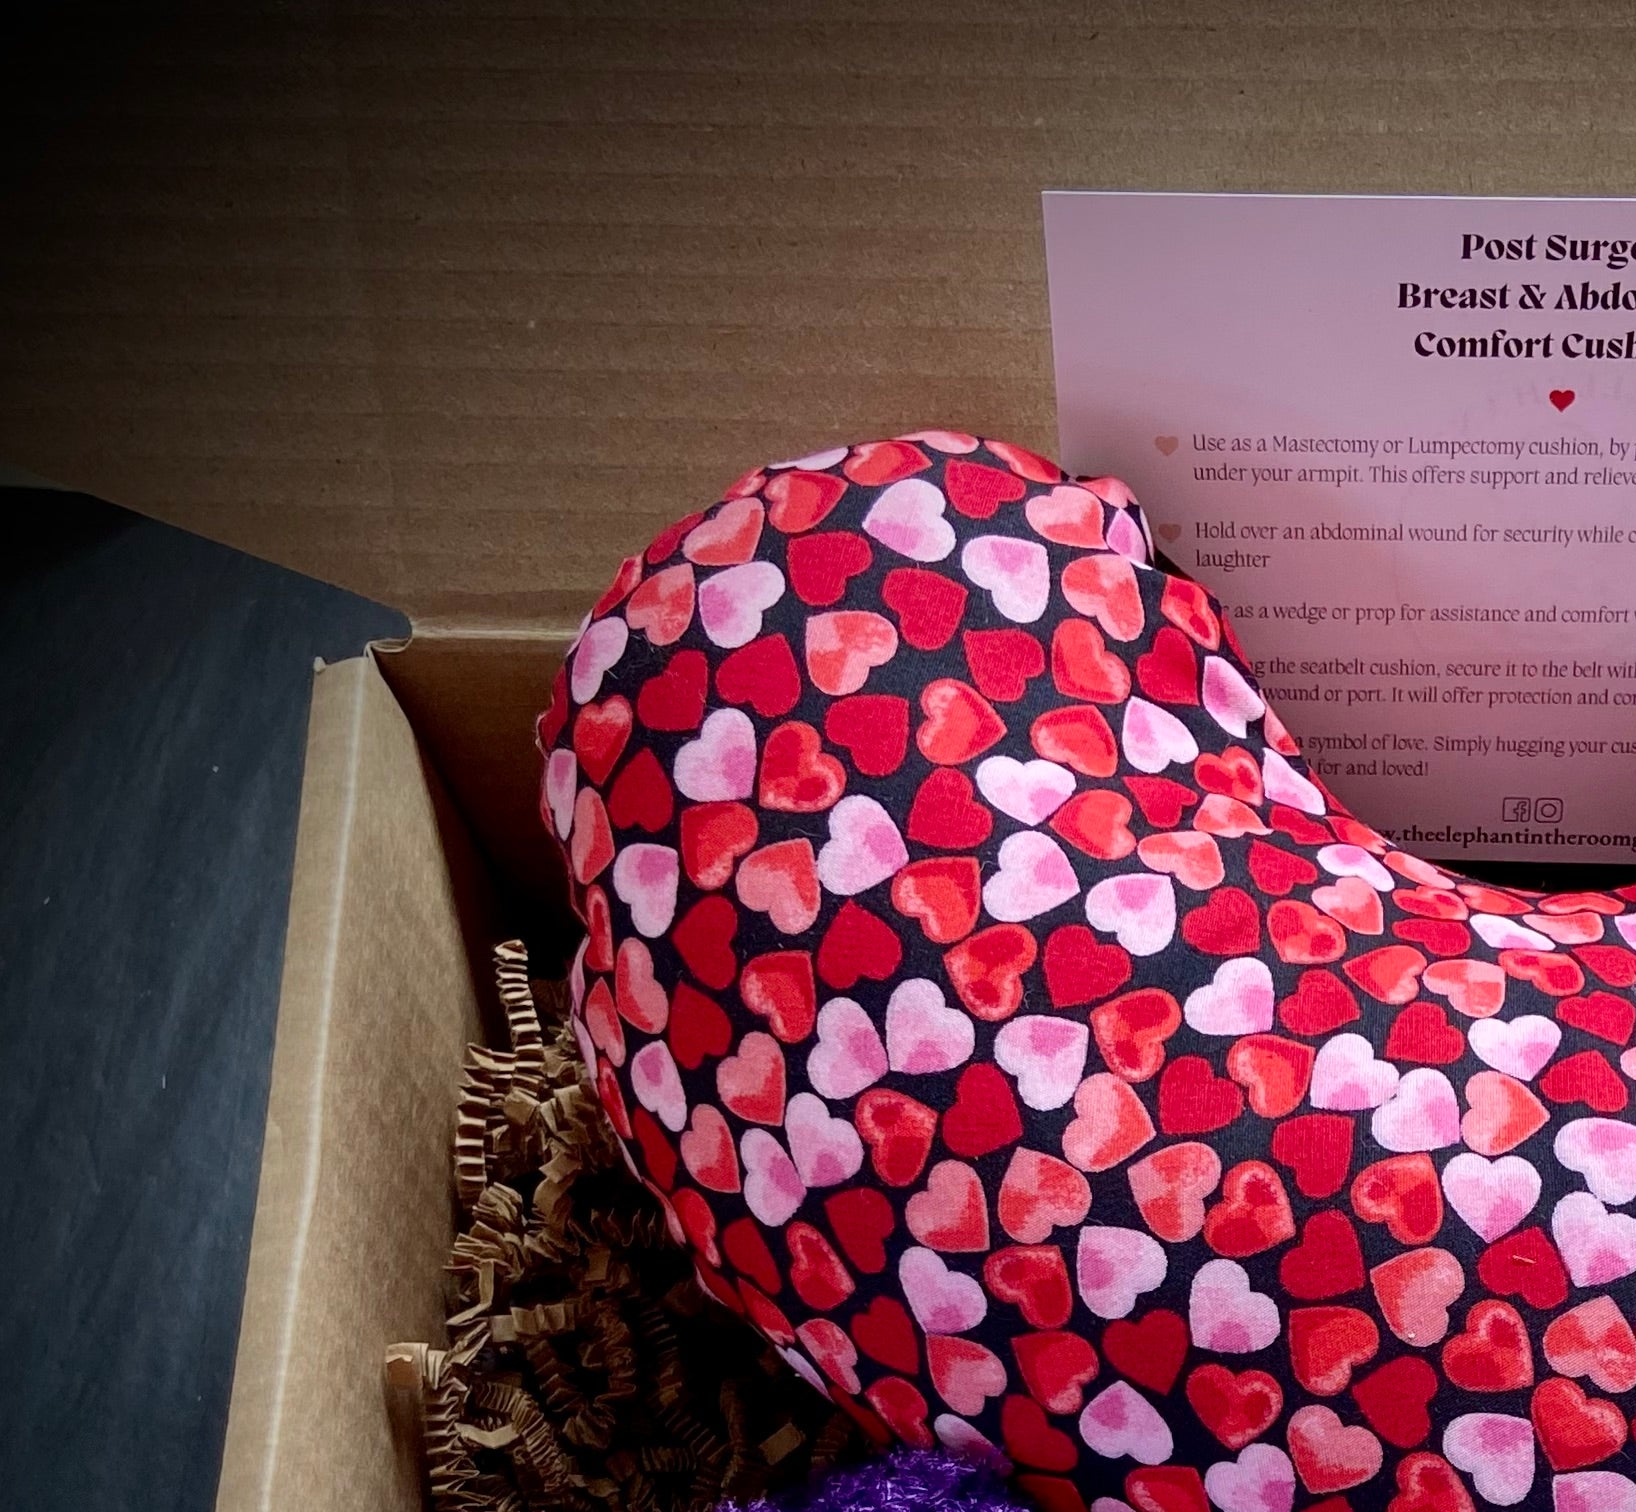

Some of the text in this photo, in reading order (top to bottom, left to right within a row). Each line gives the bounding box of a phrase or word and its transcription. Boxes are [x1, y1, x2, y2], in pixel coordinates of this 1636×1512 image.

[1461, 234, 1538, 261] Post
[1397, 283, 1511, 309] Breast
[1518, 284, 1547, 310] &
[1414, 329, 1554, 358] Comfort
[1193, 434, 1226, 452] Use
[1231, 438, 1252, 452] as
[1273, 435, 1379, 458] Mastectomy
[1383, 439, 1404, 454] or
[1408, 437, 1525, 460] Lumpectomy
[1528, 437, 1603, 457] cushion,
[1609, 437, 1630, 461] by
[1193, 464, 1248, 481] under
[1251, 467, 1293, 486] your
[1297, 465, 1364, 488] armpit.
[1368, 464, 1408, 484] This
[1411, 465, 1465, 484] offers
[1470, 470, 1541, 490] support
[1544, 466, 1579, 485] and
[1195, 521, 1236, 539] Hold
[1240, 526, 1279, 540] over
[1282, 526, 1305, 540] an
[1310, 522, 1403, 541] abdominal
[1408, 524, 1468, 542] wound
[1473, 523, 1500, 542] for
[1503, 525, 1574, 548] security
[1577, 525, 1624, 544] while
[1196, 549, 1271, 573] laughter
[1234, 605, 1254, 619] as
[1272, 602, 1328, 625] wedge
[1331, 607, 1351, 620] or
[1355, 607, 1396, 626] prop
[1400, 603, 1426, 621] for
[1430, 605, 1521, 622] assistance
[1524, 605, 1557, 623] and
[1561, 605, 1629, 623] comfort
[1269, 657, 1296, 674] the
[1300, 658, 1365, 675] seatbelt
[1369, 659, 1441, 678] cushion,
[1445, 663, 1502, 677] secure
[1522, 663, 1538, 678] to
[1542, 660, 1568, 678] the
[1572, 660, 1602, 678] belt
[1263, 686, 1320, 702] wound
[1323, 689, 1343, 702] or
[1347, 689, 1386, 707] port.
[1407, 686, 1438, 703] will
[1441, 686, 1484, 704] offer
[1488, 689, 1572, 708] protection
[1577, 688, 1609, 705] and
[1308, 733, 1367, 754] symbol
[1392, 734, 1428, 751] love.
[1433, 735, 1492, 757] Simply
[1495, 736, 1566, 758] hugging
[1568, 740, 1609, 757] your
[1317, 760, 1342, 775] for
[1345, 759, 1378, 776] and
